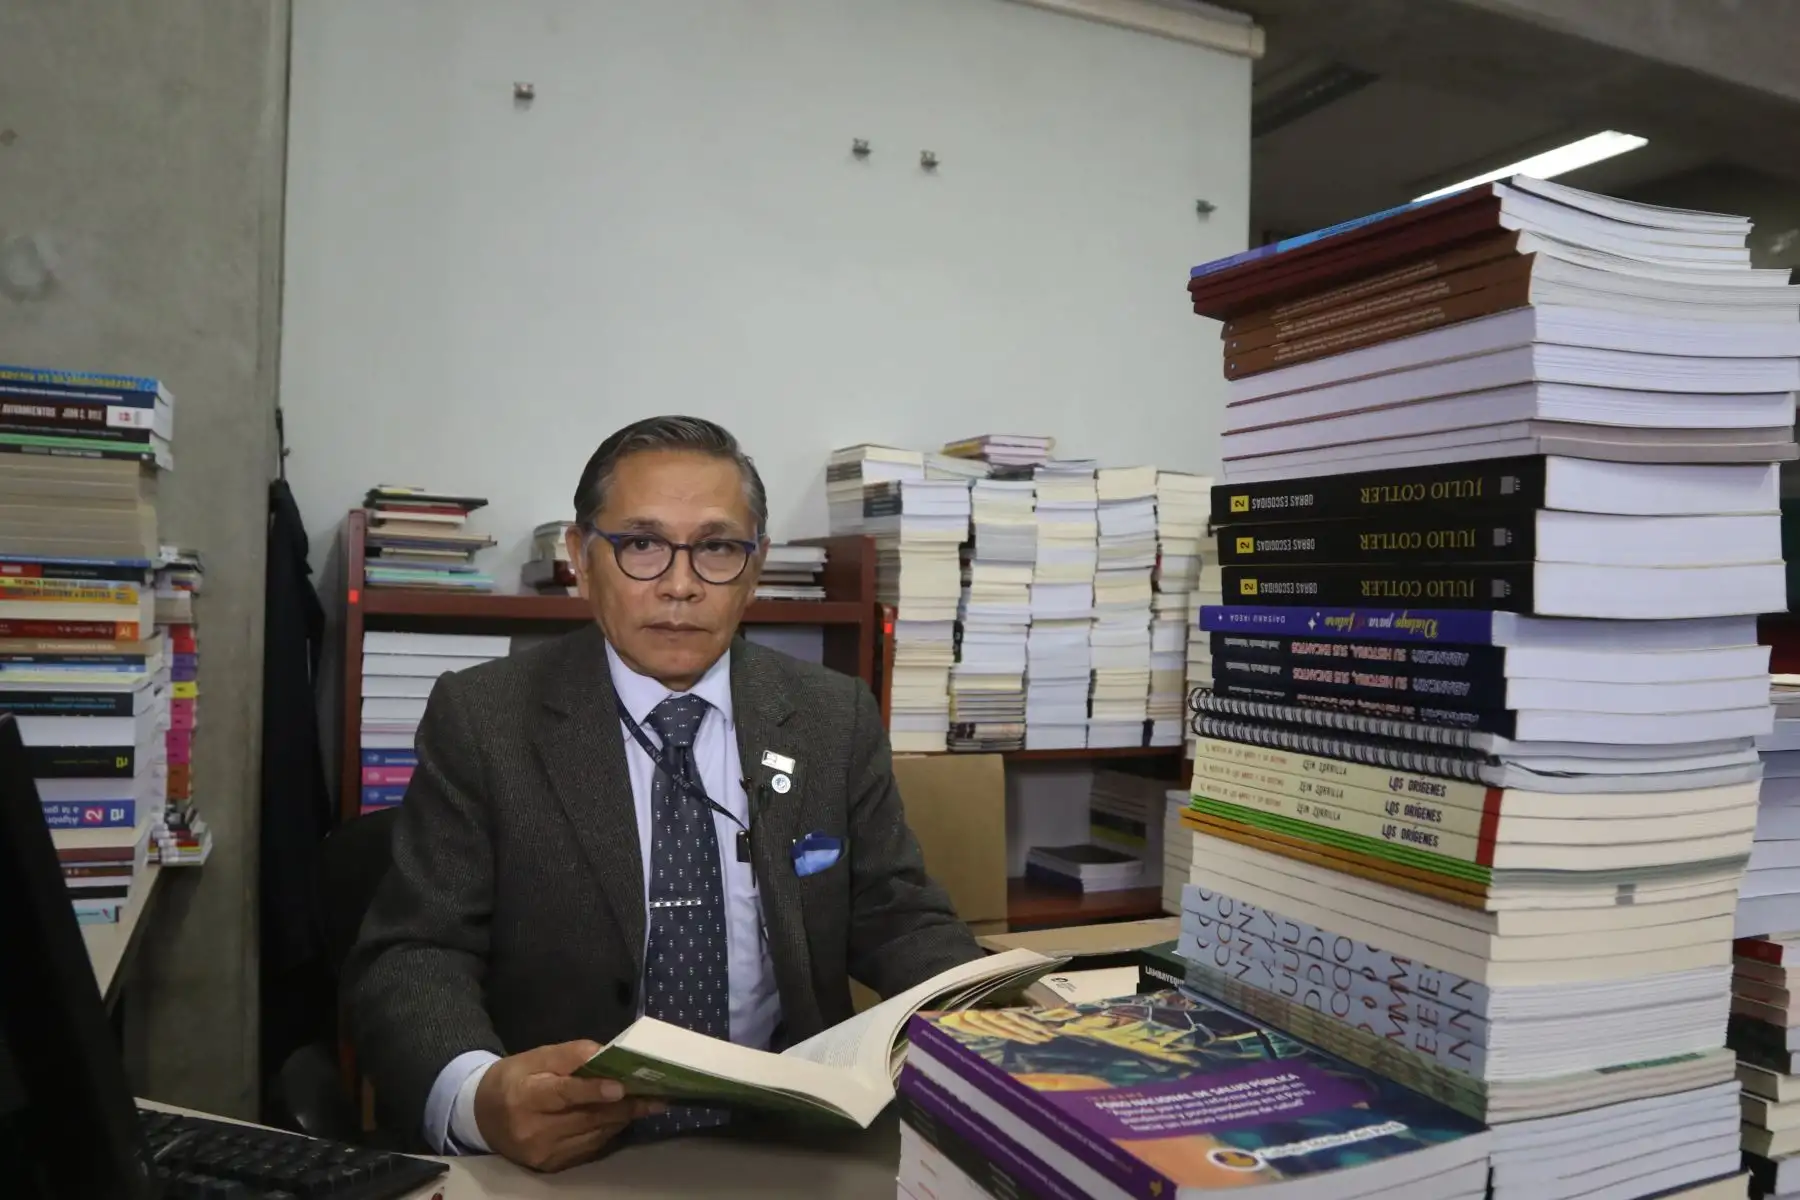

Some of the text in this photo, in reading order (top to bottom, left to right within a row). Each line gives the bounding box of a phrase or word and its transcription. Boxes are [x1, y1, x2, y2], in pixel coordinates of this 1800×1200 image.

[1360, 477, 1482, 503] JULIO COTLER
[1251, 495, 1289, 509] ESCOGIDAS
[1291, 494, 1314, 508] OBRAS
[1256, 539, 1291, 552] ESCOGIDAS
[1293, 538, 1315, 551] OBRAS
[1360, 529, 1475, 550] JULIO COTLER
[1260, 582, 1294, 595] ESCOGIDAS
[1296, 582, 1317, 594] OBRAS
[1361, 579, 1475, 598] JULIO COTLER
[1229, 613, 1286, 625] DAISAKU IKEDA
[1368, 611, 1392, 629] para
[1392, 648, 1407, 662] SU
[1393, 675, 1407, 689] SU
[1319, 761, 1348, 776] ZORRILLA
[1315, 783, 1344, 799] ZORRILLA
[1389, 776, 1447, 797] LOS ORÍGENES
[1312, 804, 1341, 821] ZORRILLA
[1385, 800, 1442, 823] LOS ORÍGENES
[1381, 824, 1439, 847] LOS ORÍGENES
[1130, 1093, 1195, 1107] NACIONAL
[1192, 1089, 1213, 1098] DE
[1209, 1082, 1252, 1095] SALUD
